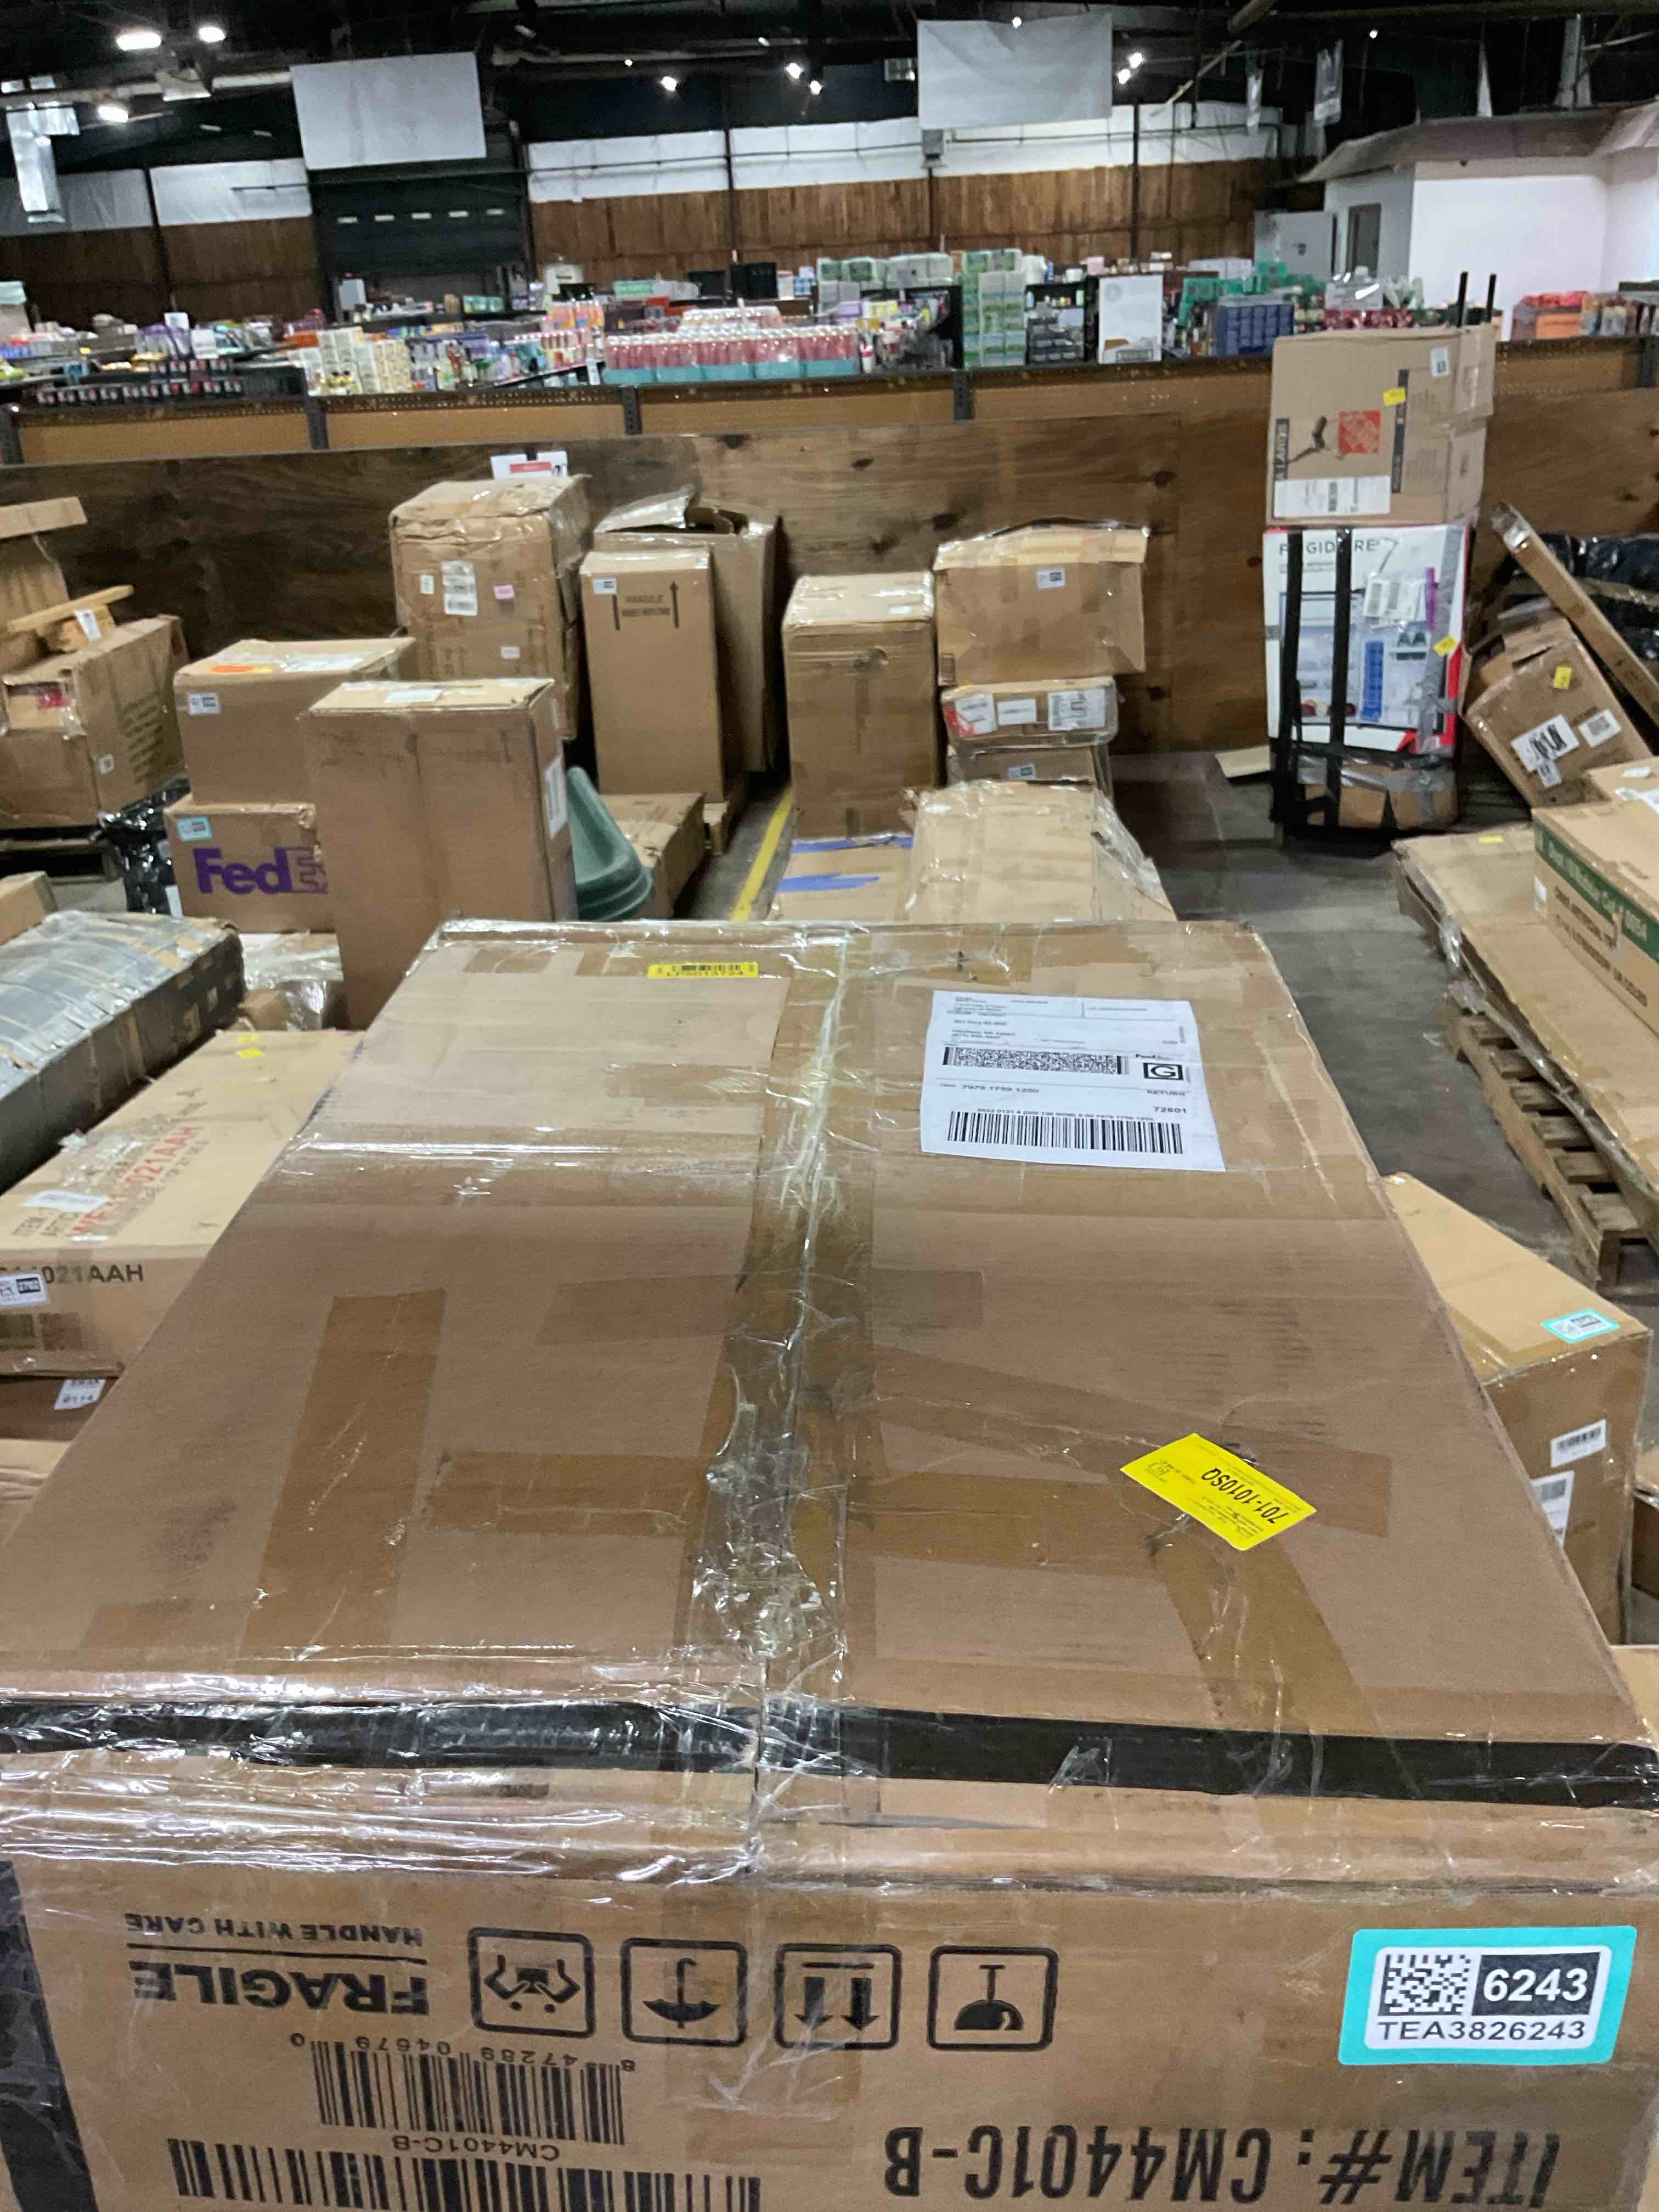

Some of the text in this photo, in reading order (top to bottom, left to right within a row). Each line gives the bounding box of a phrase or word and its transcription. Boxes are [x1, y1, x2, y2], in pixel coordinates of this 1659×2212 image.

[1279, 539, 1378, 556] FGIDRE
[193, 848, 329, 894] FedE
[1153, 1106, 1188, 1114] 72601
[1201, 1468, 1290, 1524] 701-1010SQ
[124, 1913, 423, 1946] HANDLE WITH CARE
[129, 1960, 430, 2016] FRAGILE
[1483, 1968, 1588, 2002] 6243
[1378, 2021, 1585, 2041] TEA3826243
[392, 2135, 561, 2162] CM4401C-B
[884, 2124, 1272, 2204] CM4401C-B
